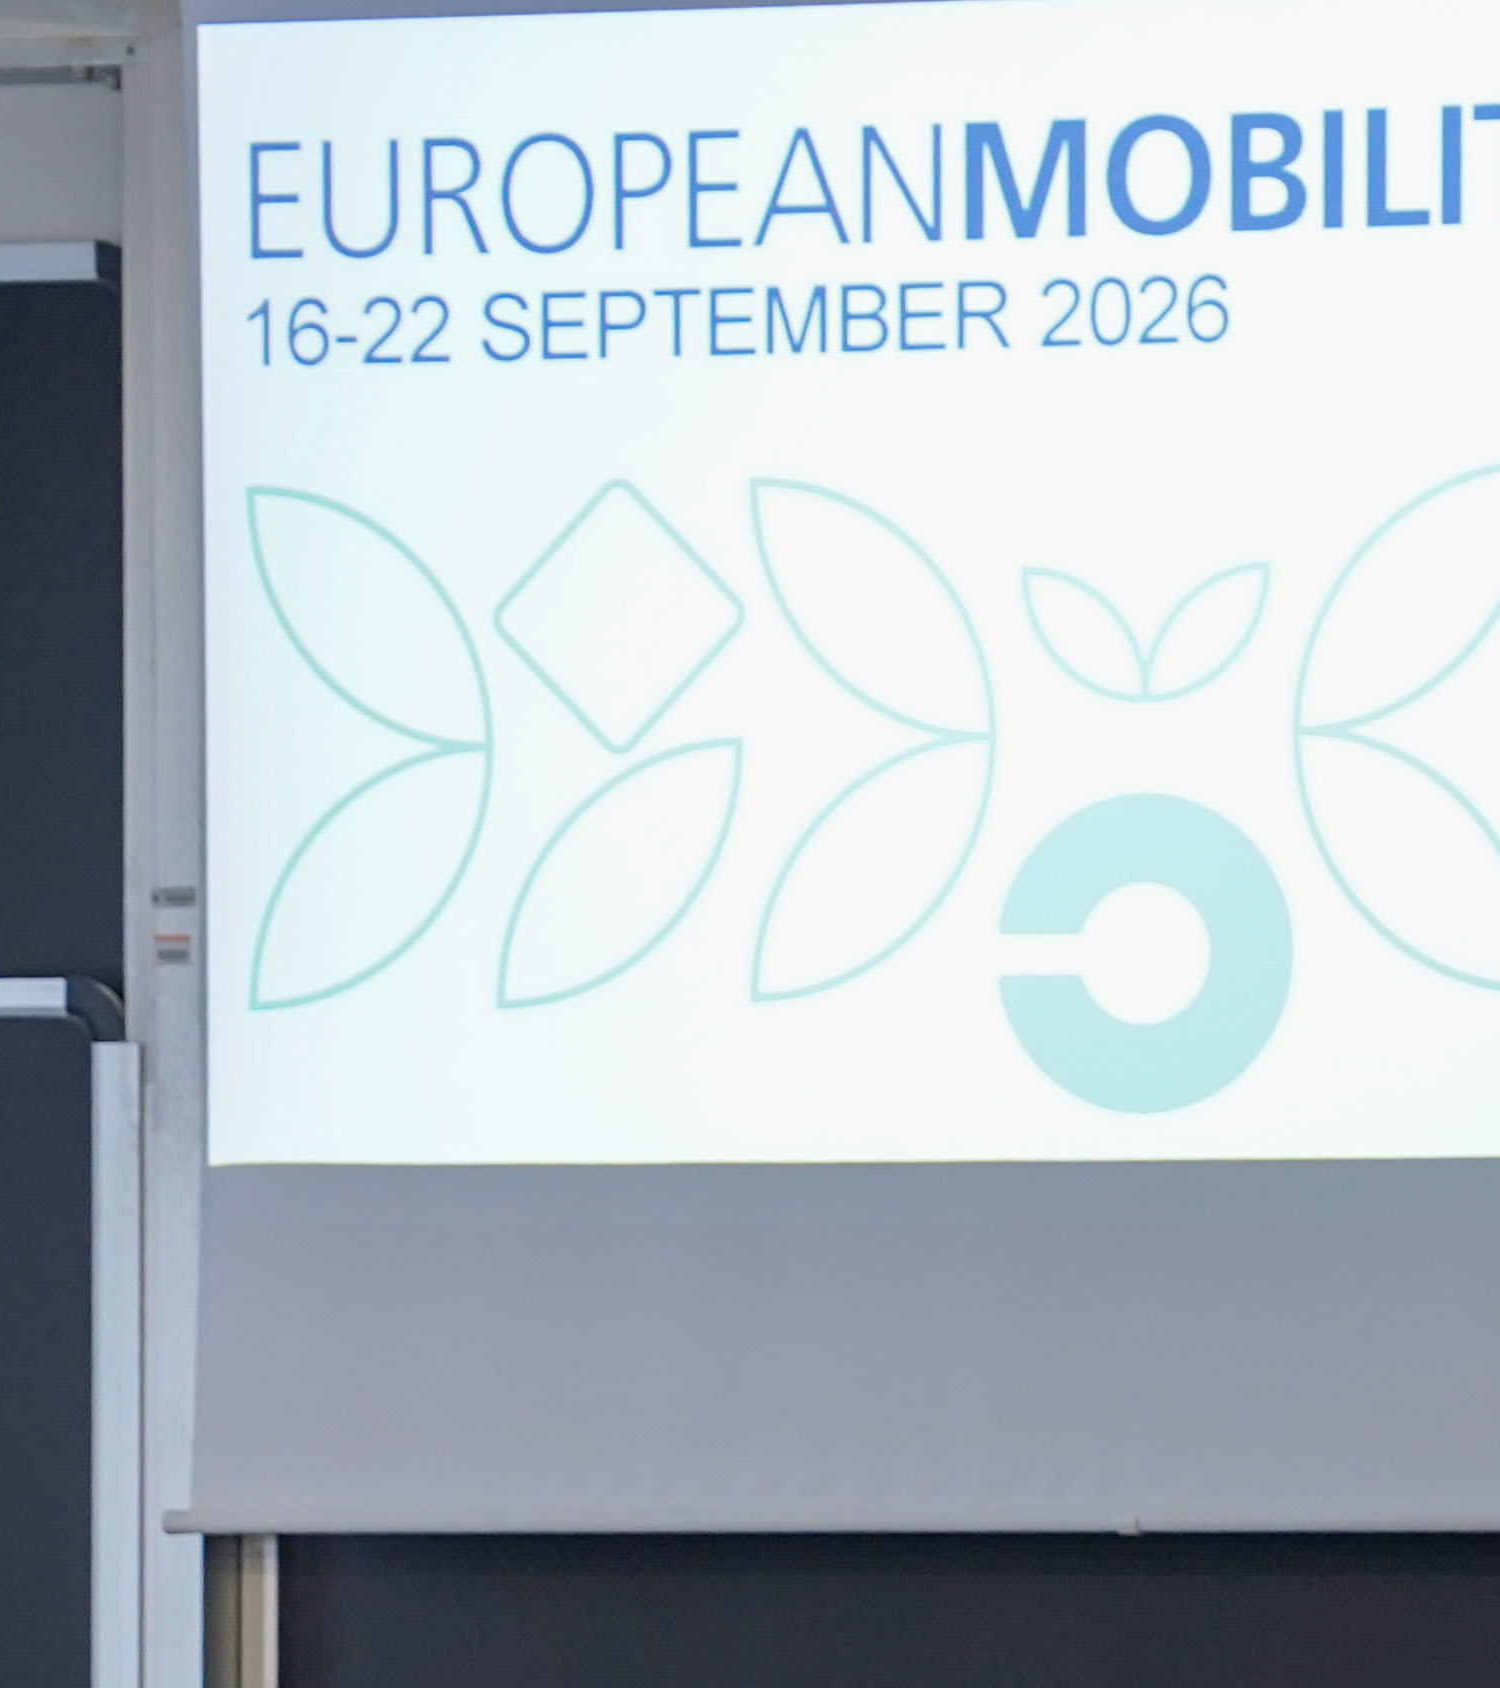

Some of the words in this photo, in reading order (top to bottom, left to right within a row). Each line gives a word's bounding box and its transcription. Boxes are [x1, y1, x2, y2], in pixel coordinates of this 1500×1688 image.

[246, 294, 452, 367] 16-22
[480, 280, 1010, 362] SEPTEMBER
[1040, 273, 1230, 347] 2026
